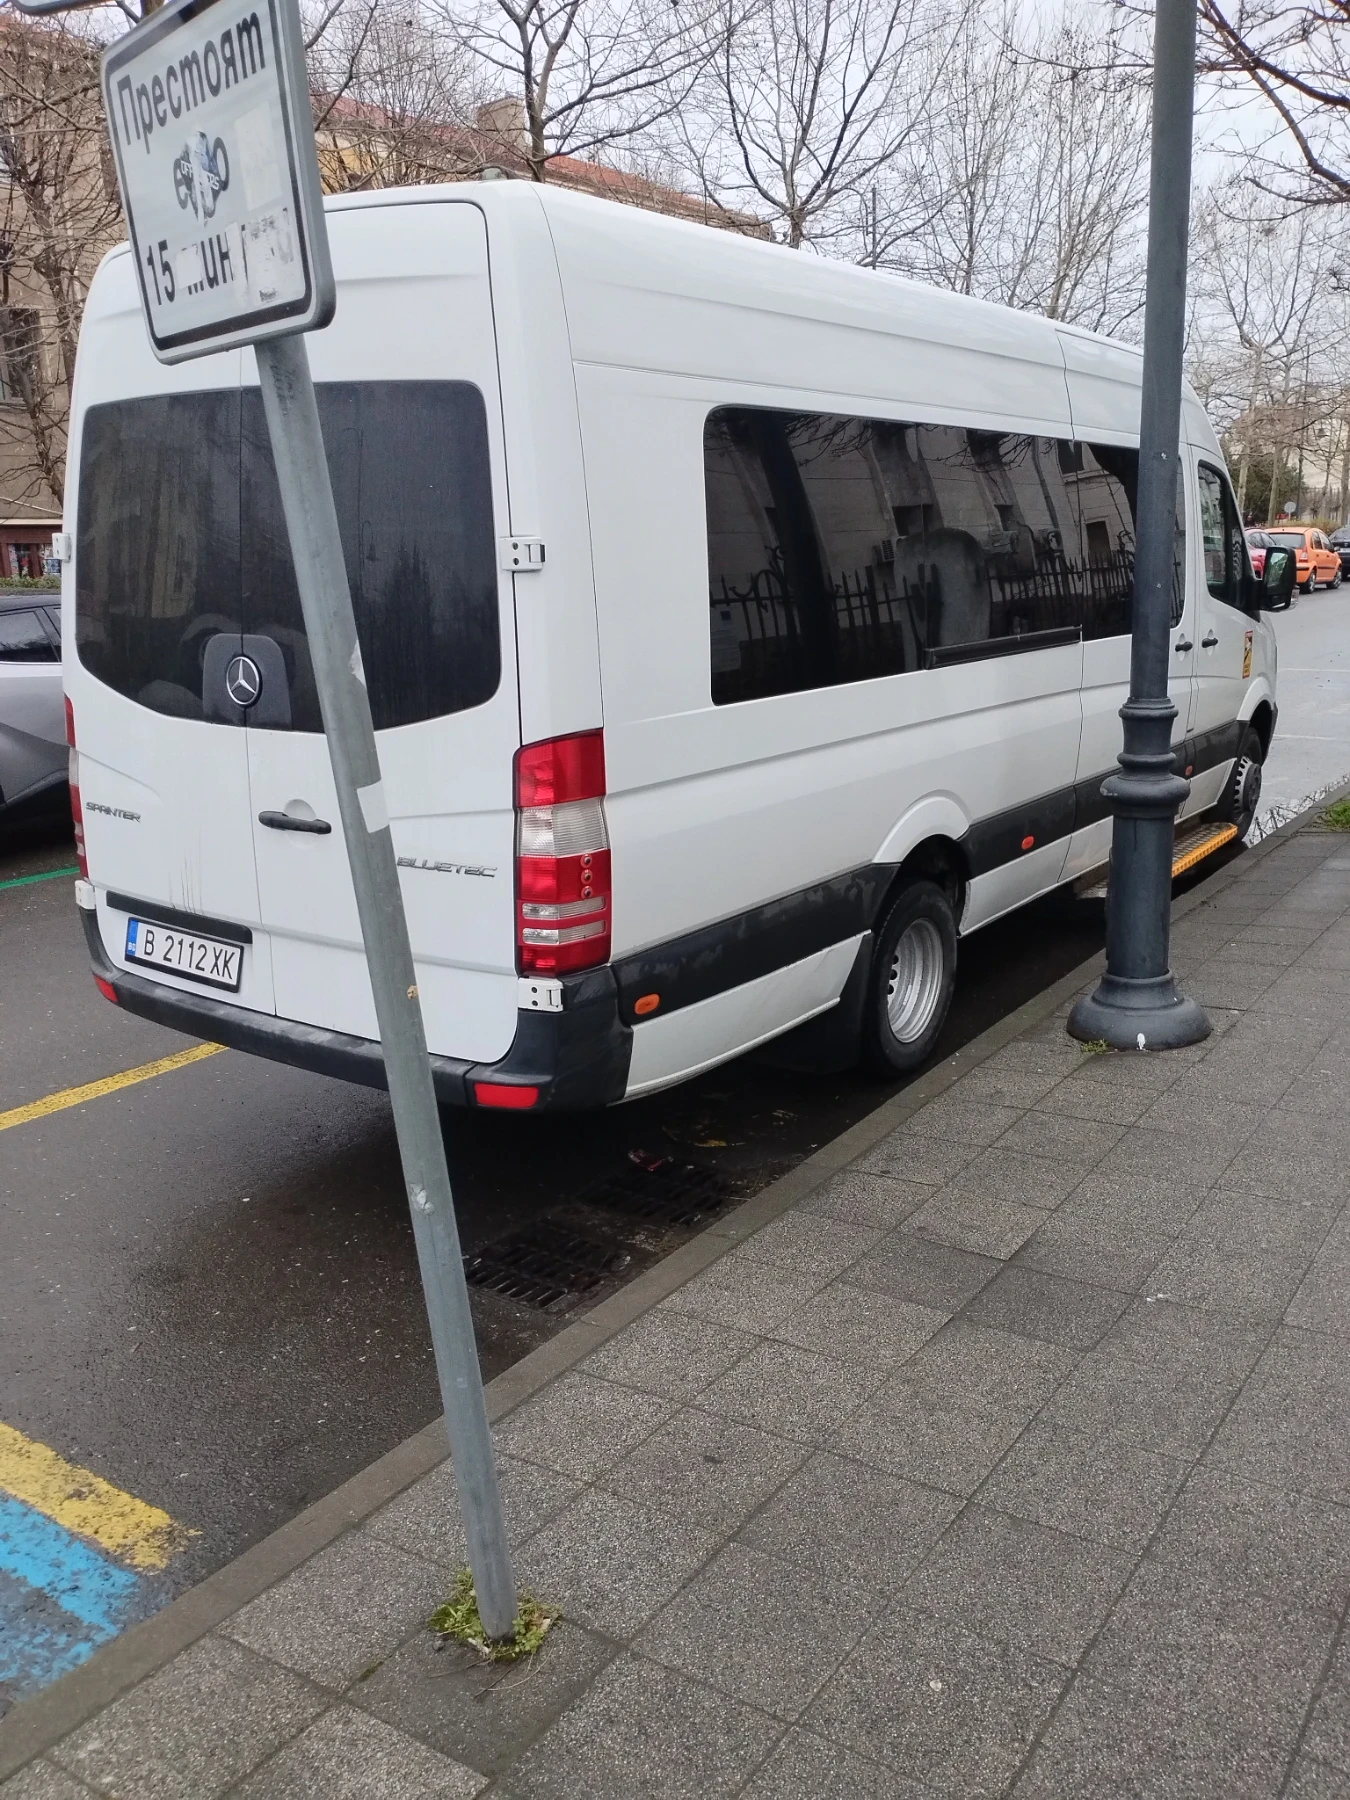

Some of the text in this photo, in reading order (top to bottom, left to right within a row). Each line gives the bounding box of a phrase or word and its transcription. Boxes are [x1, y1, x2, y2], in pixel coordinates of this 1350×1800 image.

[116, 12, 266, 155] Престоят
[146, 239, 176, 306] 15
[85, 801, 141, 824] SPRINTER
[396, 856, 498, 878] BLUETEC
[127, 942, 136, 952] BG
[144, 929, 235, 980] B 2112 XK
